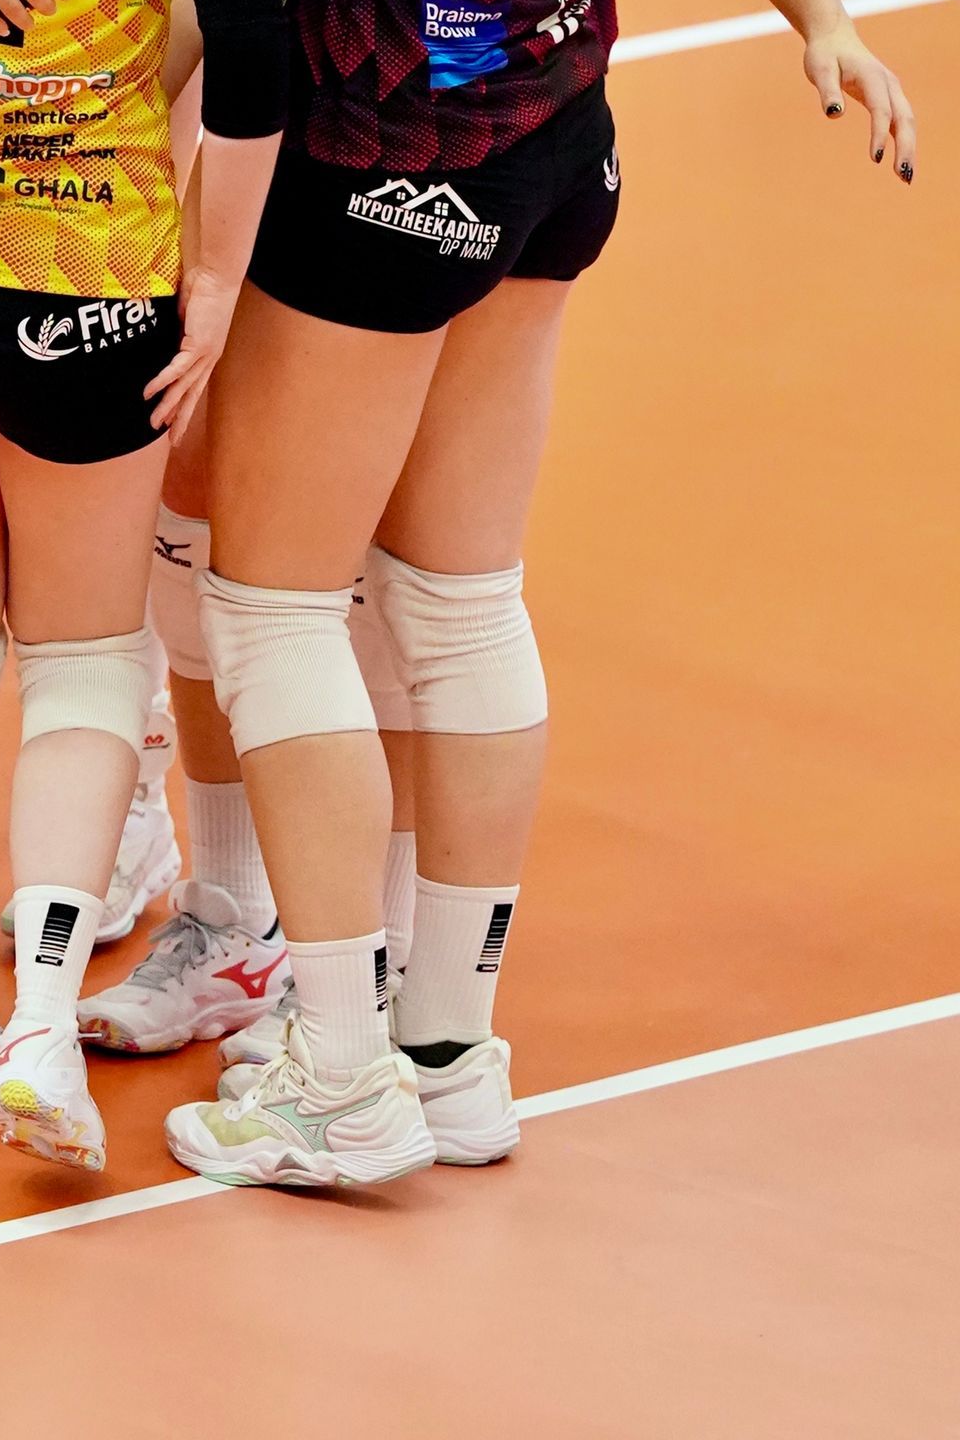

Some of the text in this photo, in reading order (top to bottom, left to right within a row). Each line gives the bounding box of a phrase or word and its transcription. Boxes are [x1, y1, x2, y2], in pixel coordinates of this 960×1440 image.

[14, 177, 114, 205] GHALA
[347, 193, 502, 244] HYPOTHEEKADVIES
[439, 237, 497, 261] OP MAAT
[84, 317, 158, 353] BAKERY
